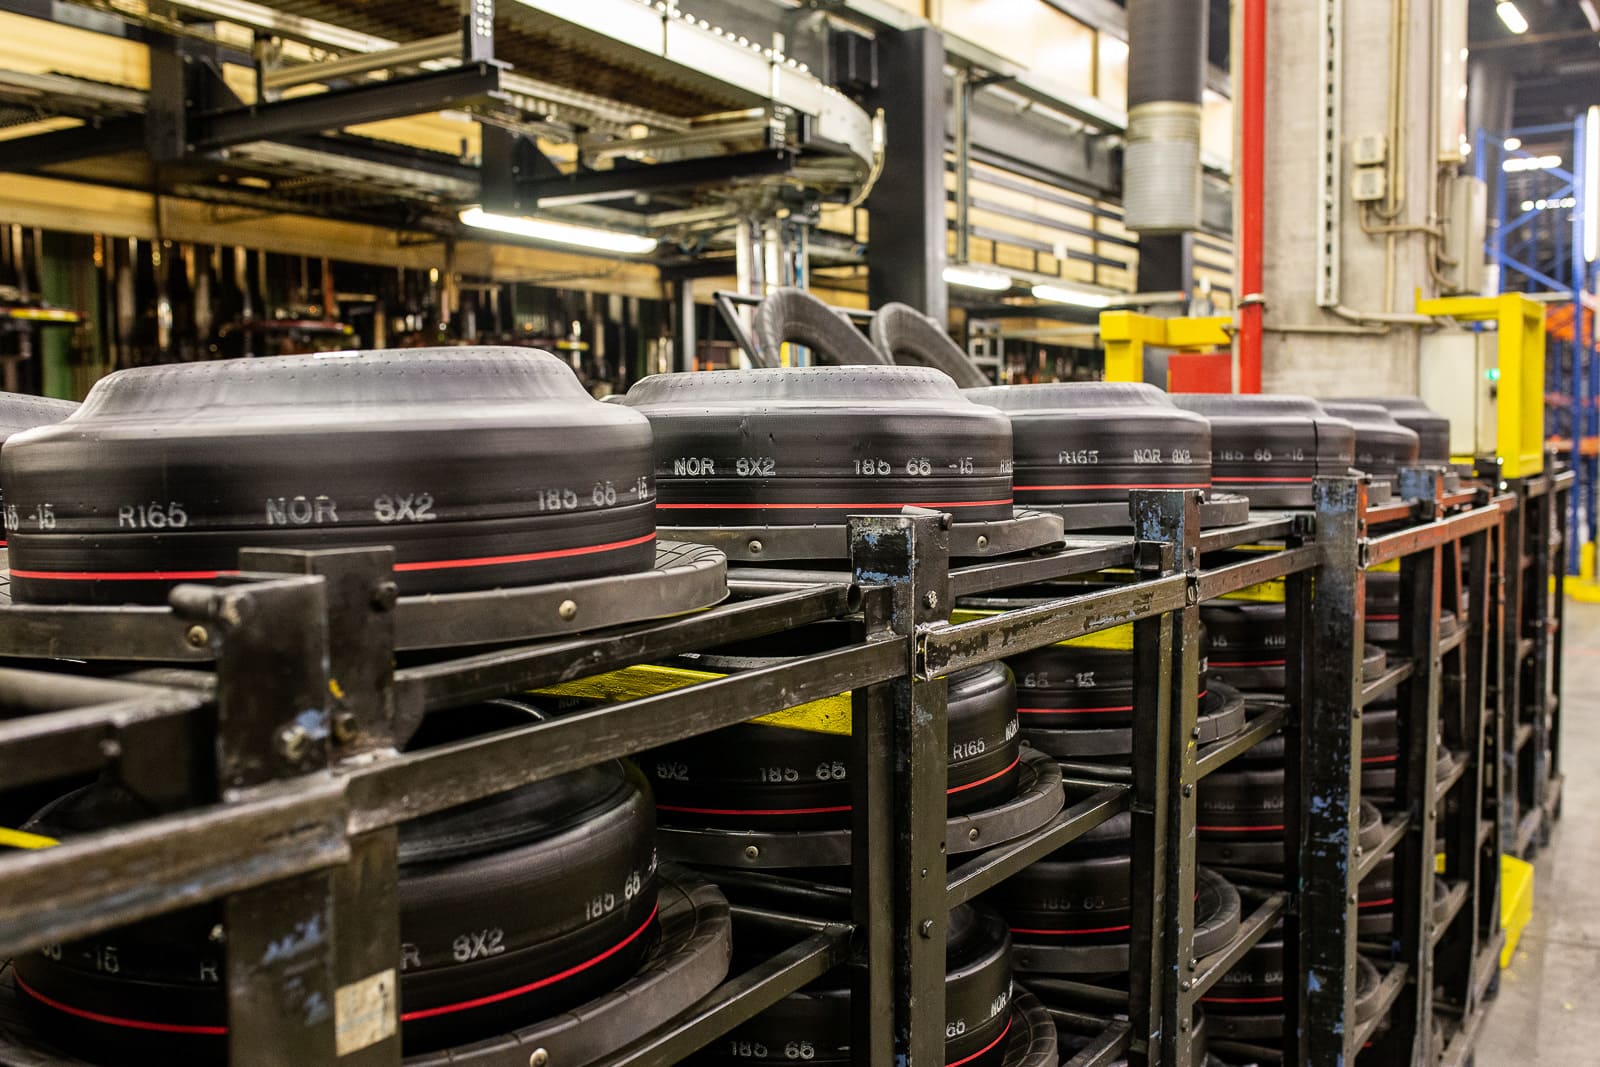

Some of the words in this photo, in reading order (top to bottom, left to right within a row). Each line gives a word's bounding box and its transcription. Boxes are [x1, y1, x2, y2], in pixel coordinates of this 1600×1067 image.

[674, 457, 715, 476] NOR
[736, 457, 776, 476] 8X2
[853, 457, 891, 476] 185
[906, 457, 932, 476] 65
[949, 456, 974, 475] -15
[1058, 449, 1099, 465] R165
[1133, 448, 1162, 463] NOR
[28, 503, 56, 530] -15
[119, 501, 187, 528] R165
[265, 495, 339, 525] NOR
[374, 491, 437, 523] 8X2
[537, 487, 578, 511] 185
[593, 480, 617, 506] 65
[1064, 671, 1096, 688] -15
[953, 736, 985, 760] R165
[656, 761, 689, 781] 8X2
[760, 767, 799, 783] 185
[815, 761, 846, 781] 65
[453, 928, 506, 962] 8X2
[585, 892, 615, 921] 185
[625, 870, 641, 900] 65
[990, 992, 1007, 1018] NOR
